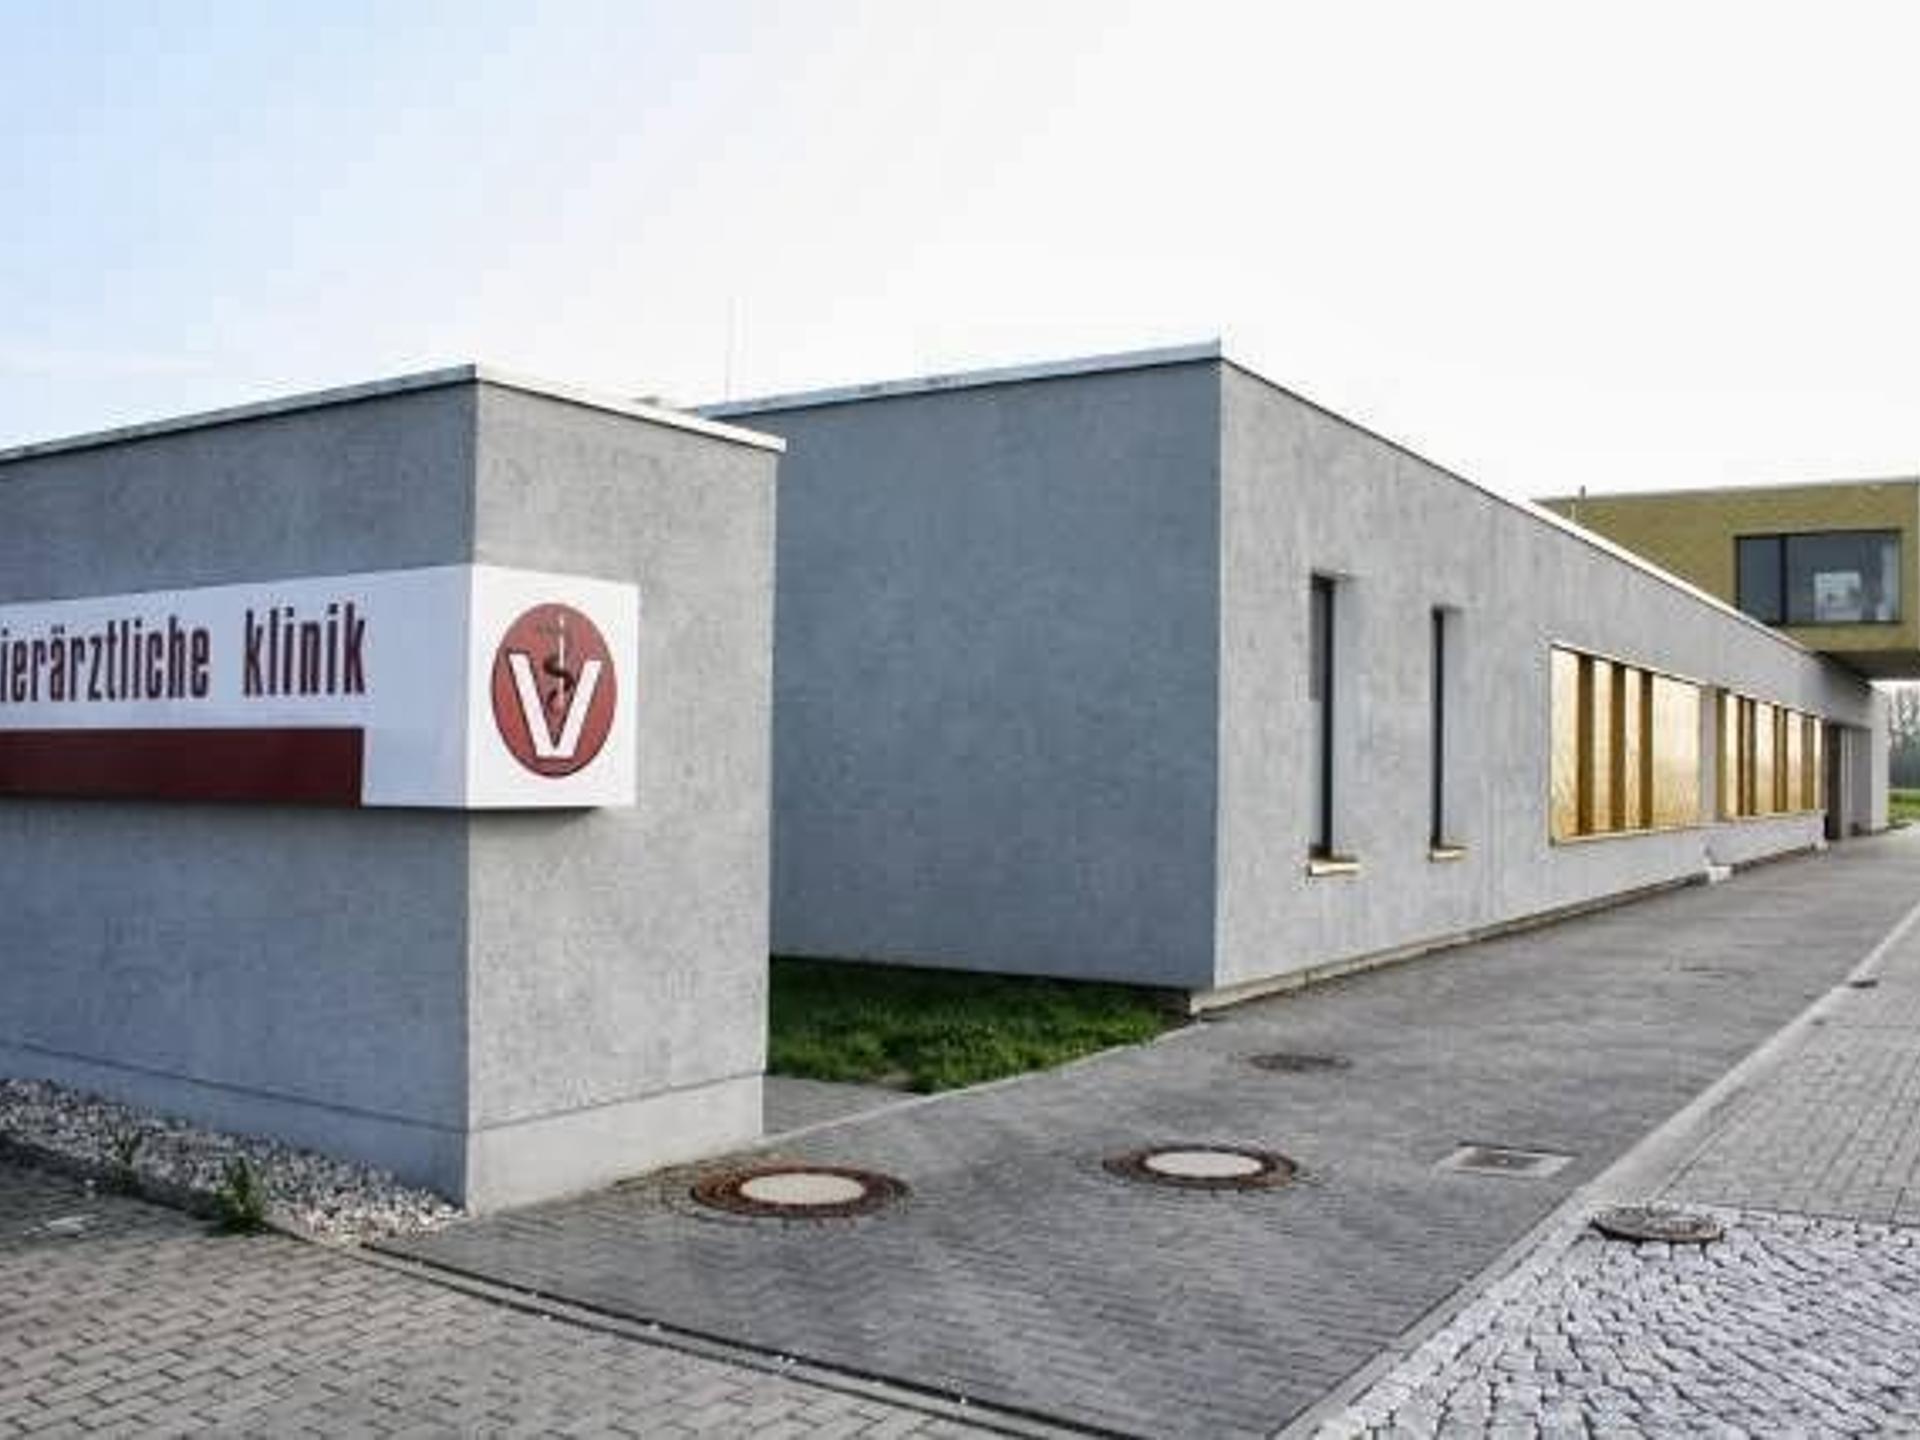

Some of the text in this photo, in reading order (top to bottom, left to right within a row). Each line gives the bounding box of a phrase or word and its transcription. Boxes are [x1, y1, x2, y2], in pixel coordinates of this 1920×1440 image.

[0, 601, 366, 702] ierärztliche klinik
[508, 651, 602, 758] V
